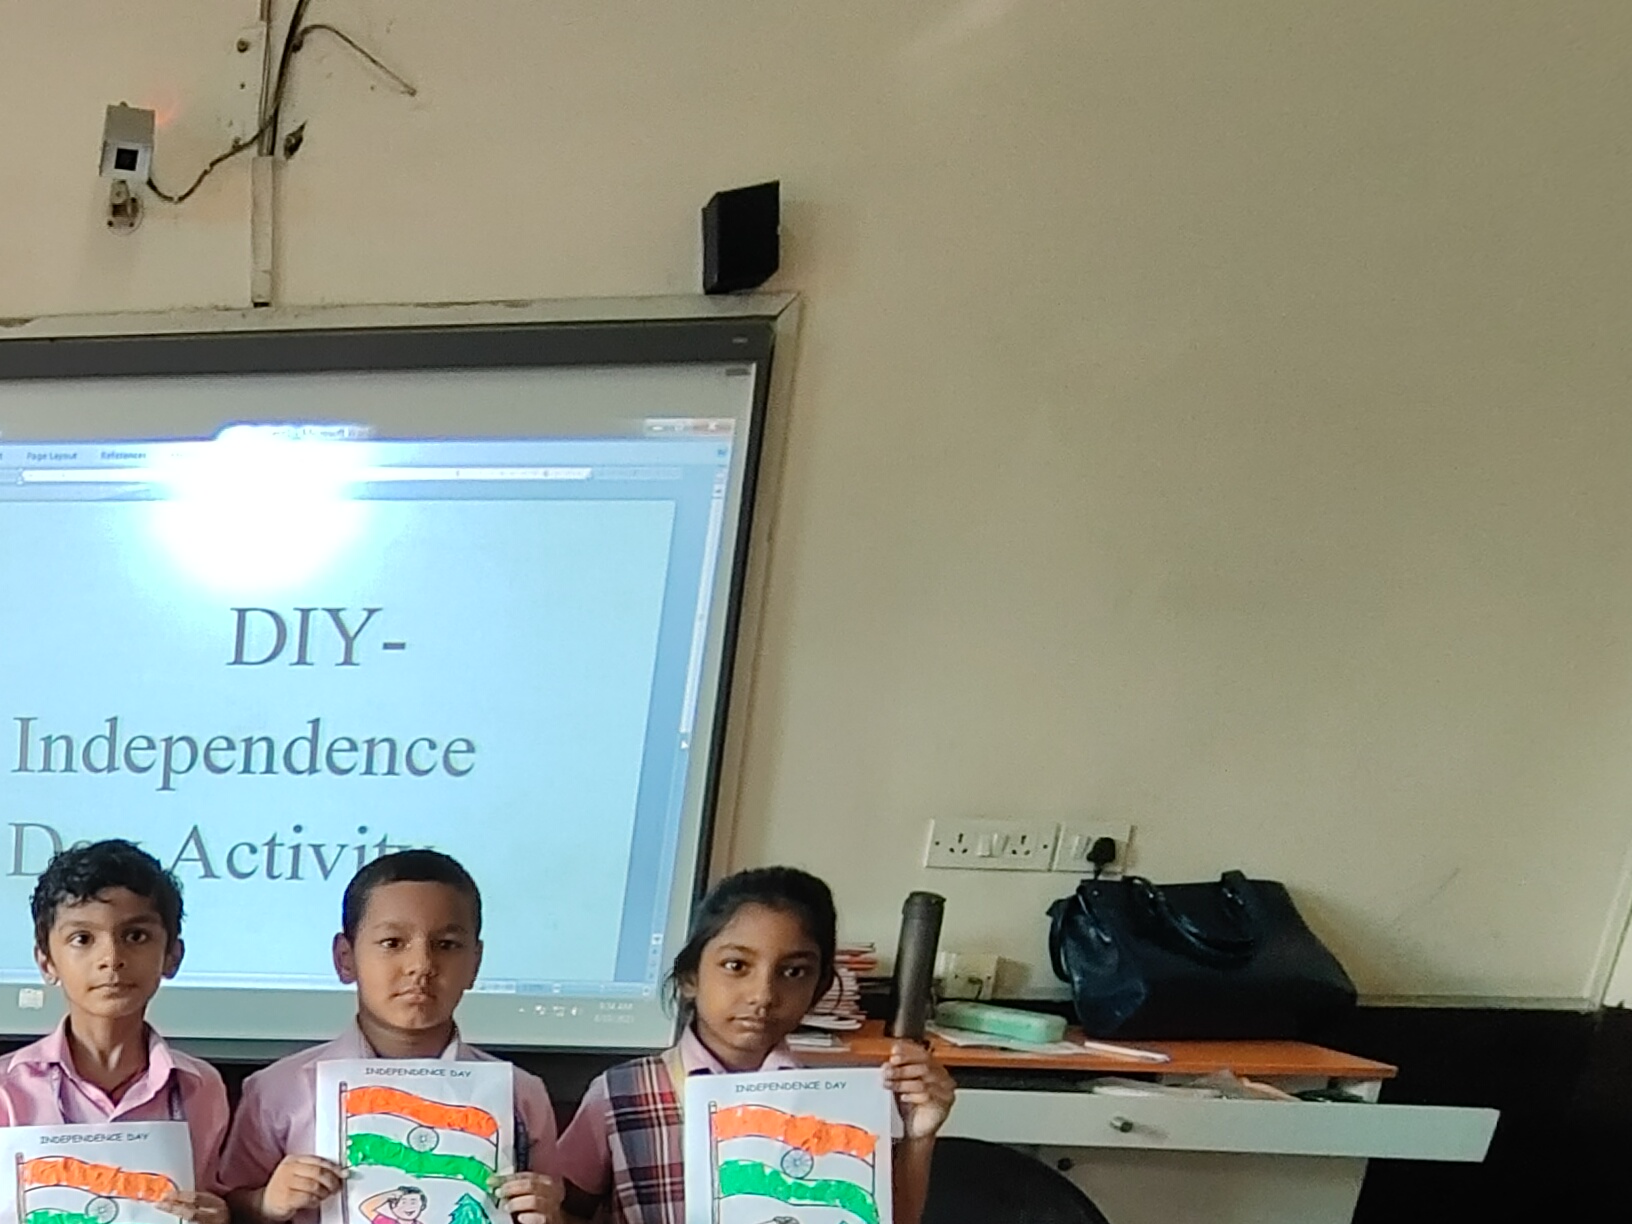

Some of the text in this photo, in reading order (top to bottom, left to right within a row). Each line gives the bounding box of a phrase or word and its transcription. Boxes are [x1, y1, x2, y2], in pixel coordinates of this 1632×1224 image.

[26, 451, 47, 462] Page
[49, 451, 78, 462] Layout
[226, 607, 406, 667] DIY-
[10, 716, 477, 792] Independence
[165, 823, 436, 882] Activit
[365, 1067, 472, 1078] INDEPENDENCE DAY
[735, 1080, 847, 1093] INDEPENDENCE DAY
[40, 1132, 150, 1144] INDEPENDENCE DAY
